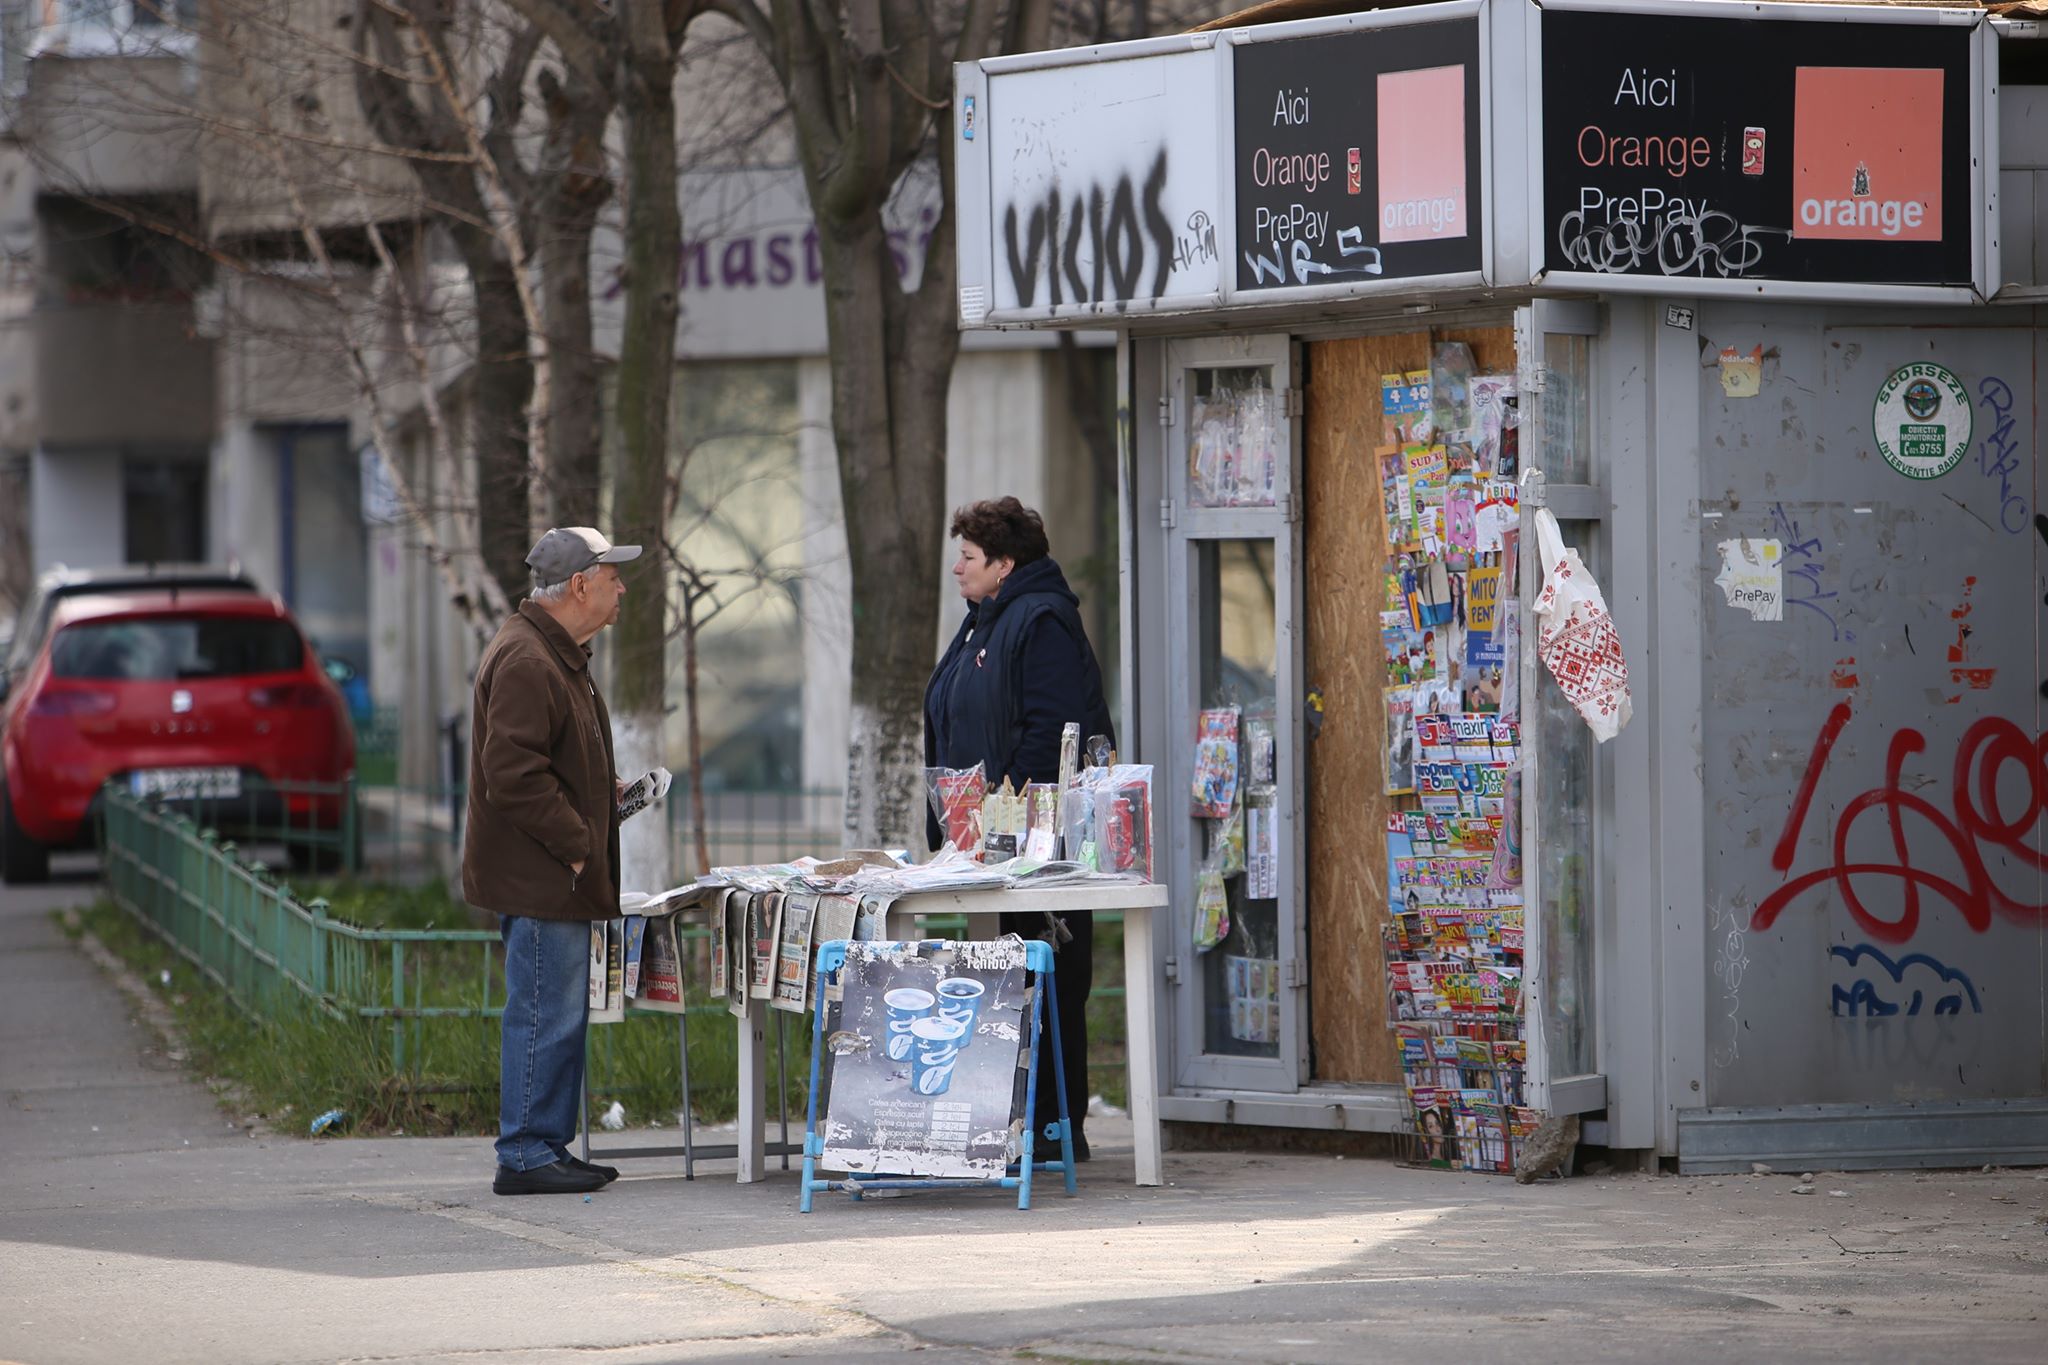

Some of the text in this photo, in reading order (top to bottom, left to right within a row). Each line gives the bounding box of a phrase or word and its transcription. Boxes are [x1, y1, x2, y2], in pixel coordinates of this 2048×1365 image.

[1273, 87, 1310, 127] Aici
[1615, 67, 1677, 108] Aici
[1577, 124, 1711, 178] Orange
[1253, 149, 1330, 193] Orange
[1255, 203, 1330, 248] PrePay
[1383, 195, 1457, 234] orange
[1580, 187, 1707, 228] PrePay
[1800, 196, 1924, 236] orange
[1879, 365, 1967, 406] SCORSEZE
[1901, 433, 1945, 442] MONITORIZAT
[1908, 426, 1938, 434] OBIECTIV
[1919, 443, 1942, 455] 9755
[1880, 441, 1967, 477] INTERVENTIE RAPIDA
[1471, 577, 1498, 601] MITO
[1734, 589, 1776, 604] PrePay
[884, 1129, 923, 1139] appuccino
